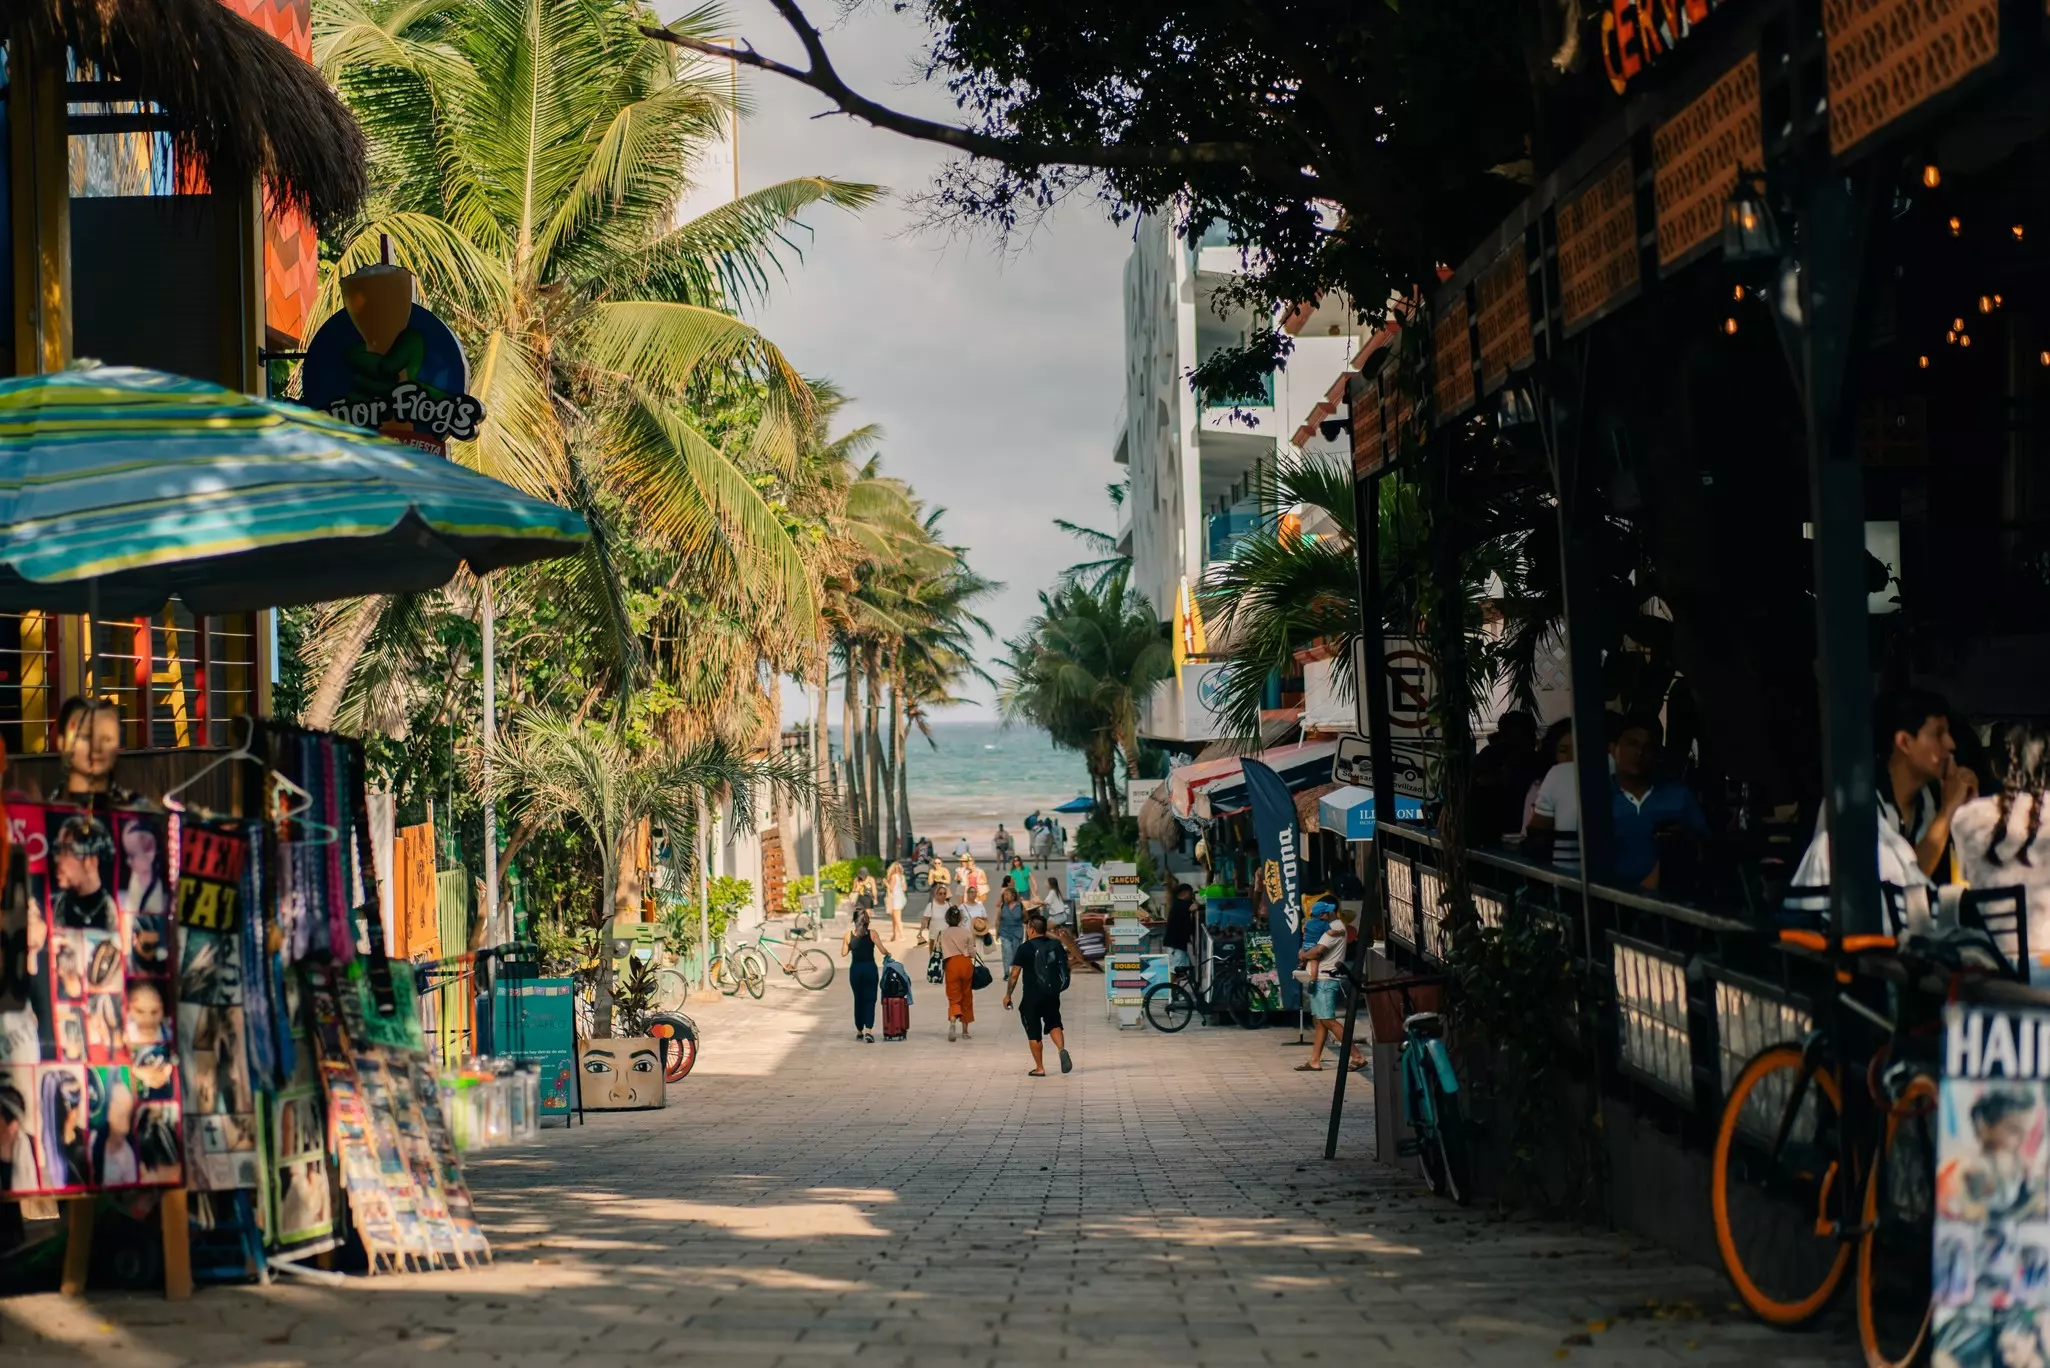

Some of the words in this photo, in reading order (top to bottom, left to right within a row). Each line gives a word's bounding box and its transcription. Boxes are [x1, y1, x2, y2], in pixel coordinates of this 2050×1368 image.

[317, 398, 387, 427] ñor
[392, 384, 475, 436] Frog's
[410, 439, 441, 456] FIESTA
[1109, 876, 1140, 884] CANCUN
[1279, 826, 1300, 935] Corona
